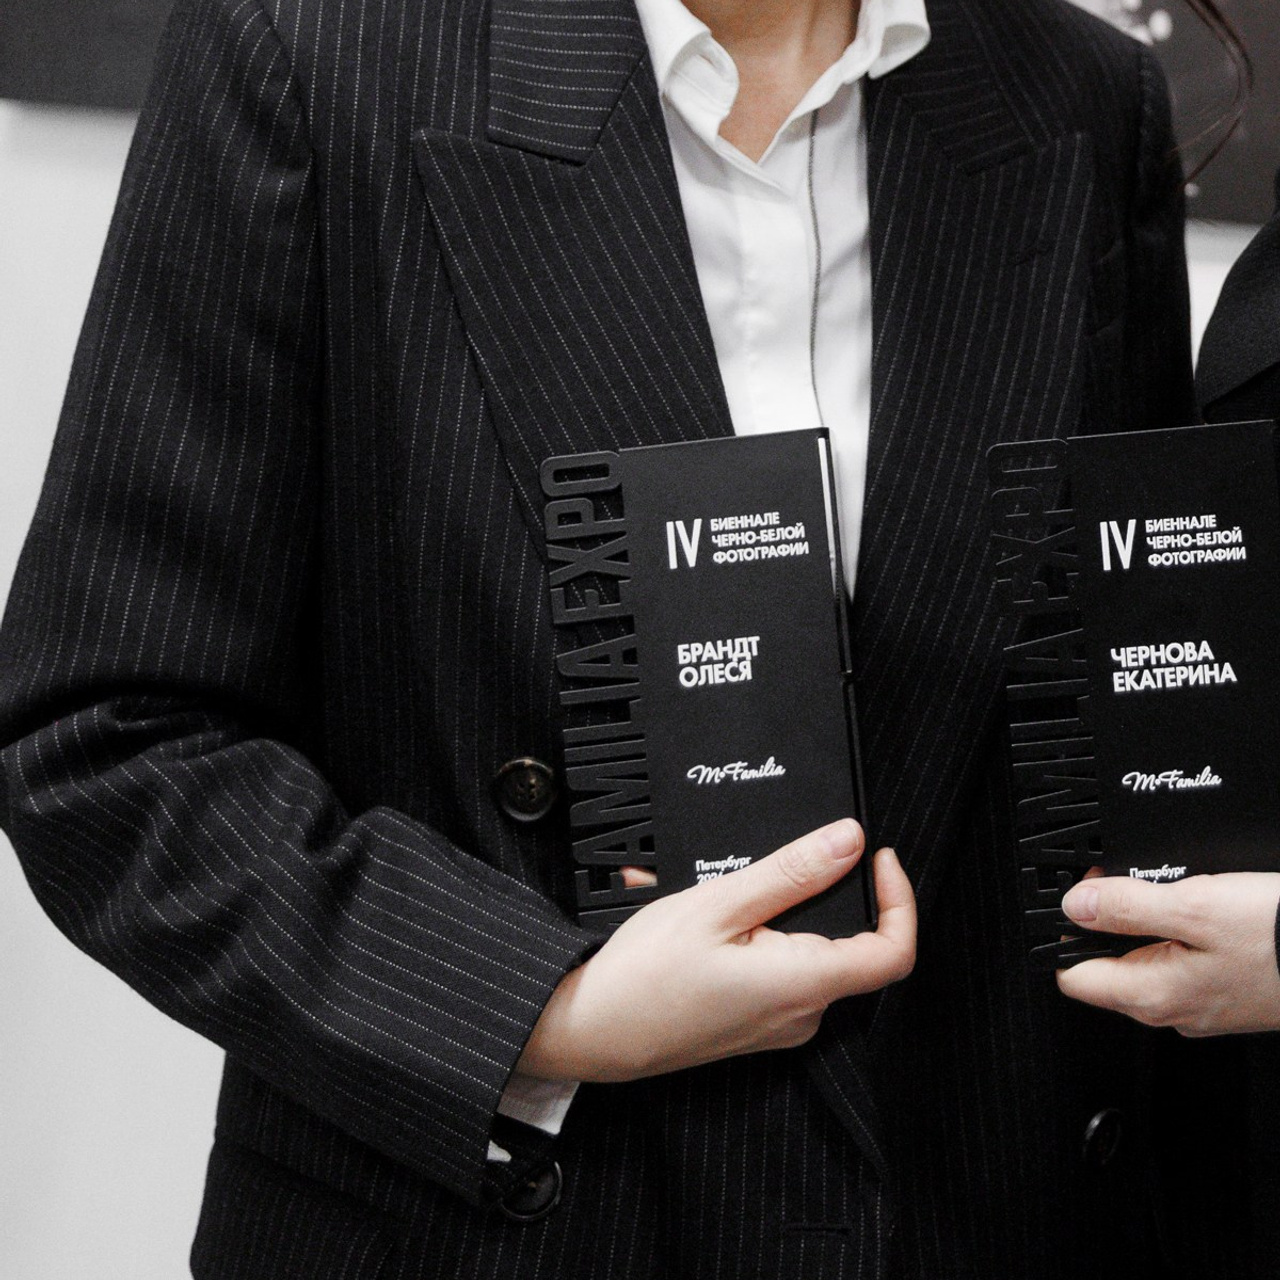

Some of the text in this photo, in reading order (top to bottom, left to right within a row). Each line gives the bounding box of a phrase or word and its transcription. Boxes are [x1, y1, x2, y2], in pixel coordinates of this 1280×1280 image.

[710, 511, 781, 532] БИЕННАЛЕ
[1145, 514, 1217, 534] БИЕННАЛЕ
[666, 518, 703, 570] IV
[712, 522, 806, 548] ЧЕРНО-БЕЛОЙ
[1100, 519, 1137, 571] IV
[1146, 526, 1243, 550] ЧЕРНО-БЕЛОЙ
[713, 541, 810, 564] ФОТОГРАФИИ
[1147, 546, 1247, 567] ФОТОГРАФИИ
[677, 635, 761, 665] БРАНДТ
[1110, 640, 1215, 668] ЧЕРНОВА
[679, 660, 753, 688] ОЛЕСЯ
[1112, 662, 1238, 693] ЕКАТЕРИНА
[695, 854, 753, 872] Петербург
[1129, 864, 1188, 880] Петербург
